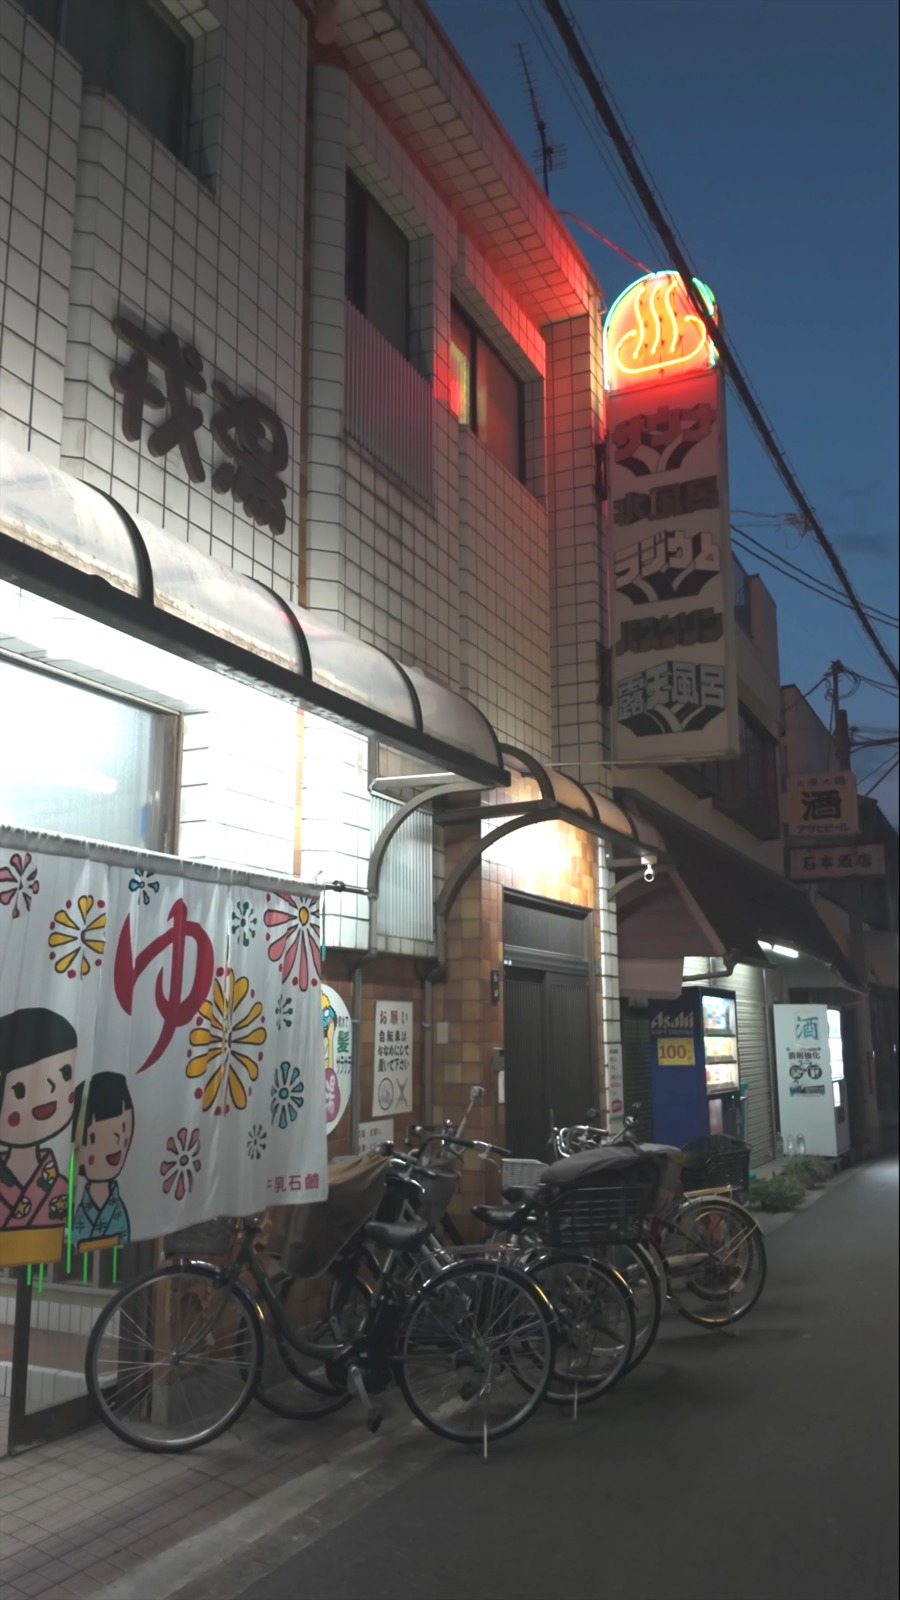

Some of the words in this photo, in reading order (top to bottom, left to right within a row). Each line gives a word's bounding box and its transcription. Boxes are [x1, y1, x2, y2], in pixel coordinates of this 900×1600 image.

[612, 402, 716, 472] サウナ
[613, 475, 719, 527] 水風呂
[614, 530, 720, 598] ラジウム
[617, 661, 725, 730] 露天風呂
[801, 789, 841, 821] 酒
[797, 824, 849, 833] アサヒビール
[803, 852, 872, 870] 石本酒店
[114, 898, 215, 1074] ゆ
[380, 1010, 408, 1025] お願い
[650, 1010, 694, 1028] Asahi
[379, 1030, 407, 1042] 自転車は
[795, 1016, 819, 1040] 酒
[337, 1030, 349, 1053] 髪
[378, 1044, 409, 1056] ななめにして
[659, 1044, 687, 1059] 100
[378, 1058, 409, 1072] 置いて下さい
